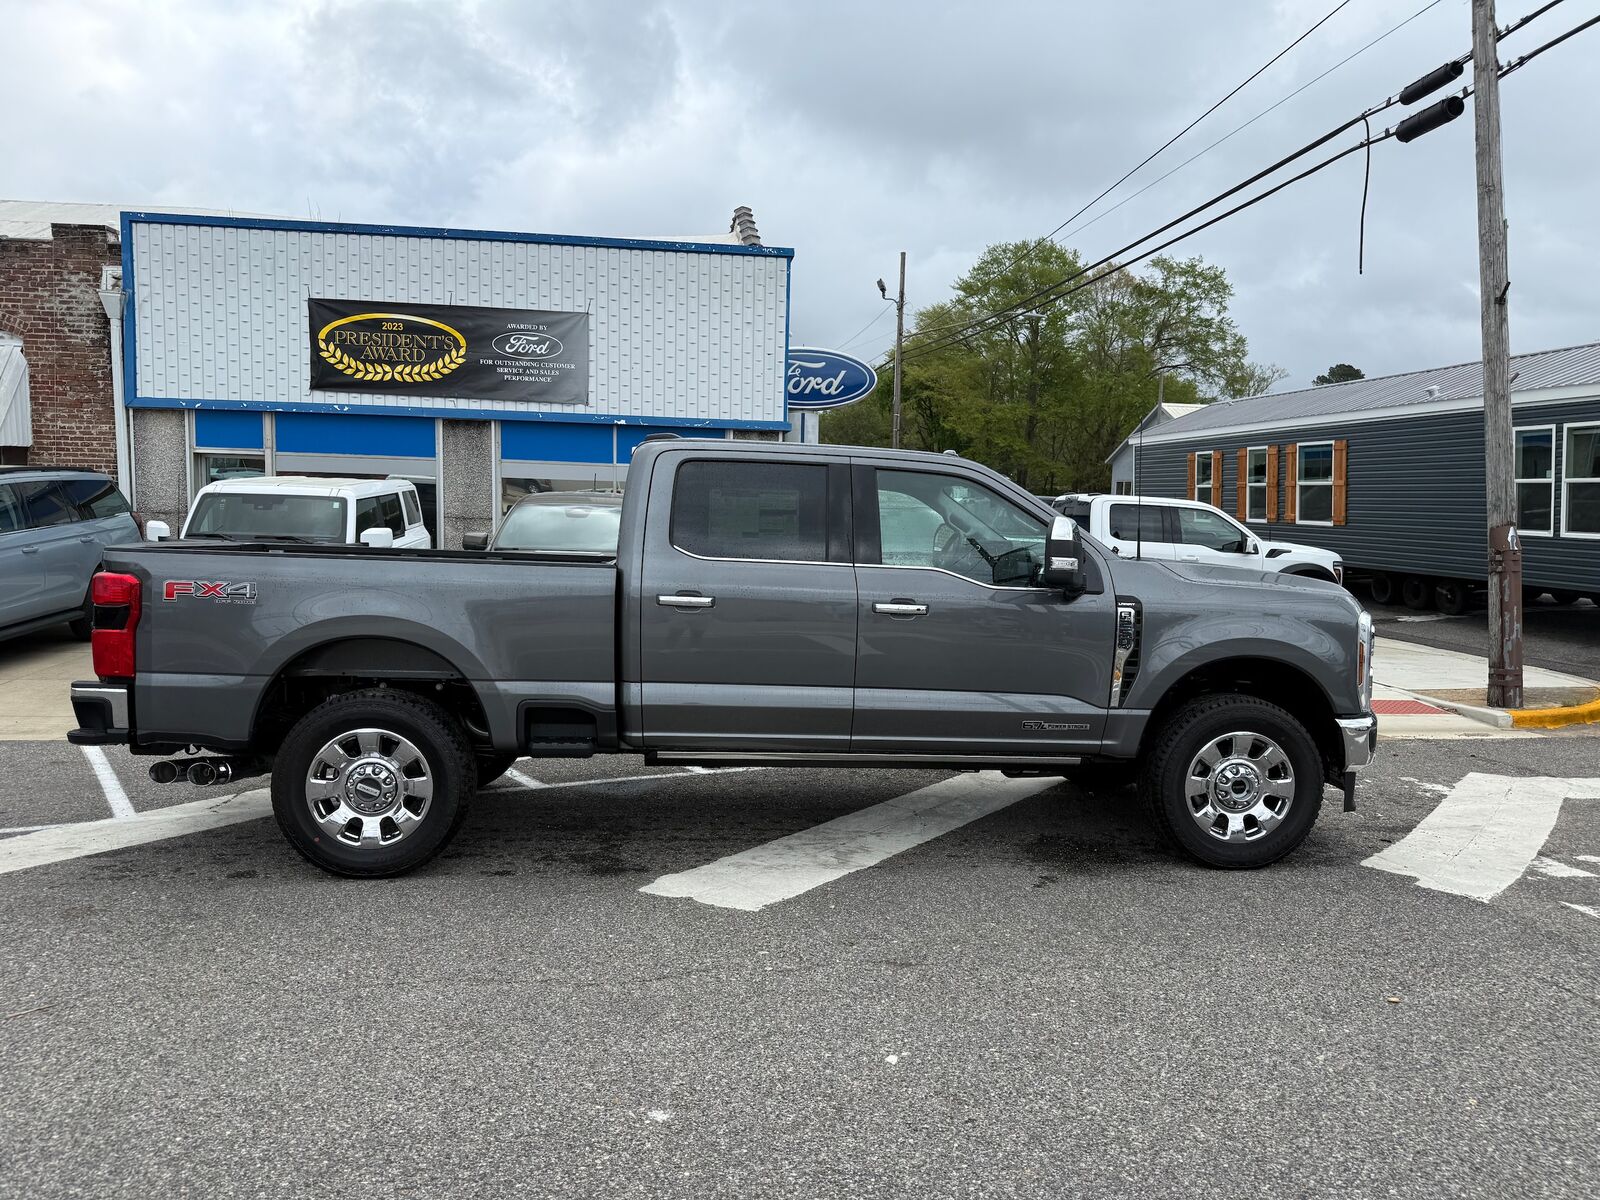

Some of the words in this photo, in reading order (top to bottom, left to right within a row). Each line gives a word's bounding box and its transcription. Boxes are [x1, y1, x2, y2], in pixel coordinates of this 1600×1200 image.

[382, 322, 404, 331] 2023
[506, 323, 538, 331] AWARDED
[333, 330, 454, 350] PRESIDENT'S
[505, 334, 550, 354] Ford
[360, 346, 426, 362] AWARD
[494, 359, 540, 368] OUTSTANDING
[540, 361, 576, 370] CUSTOMER
[496, 367, 524, 375] SERVICE
[504, 375, 553, 383] PERFORMANCE
[163, 580, 257, 602] FX4
